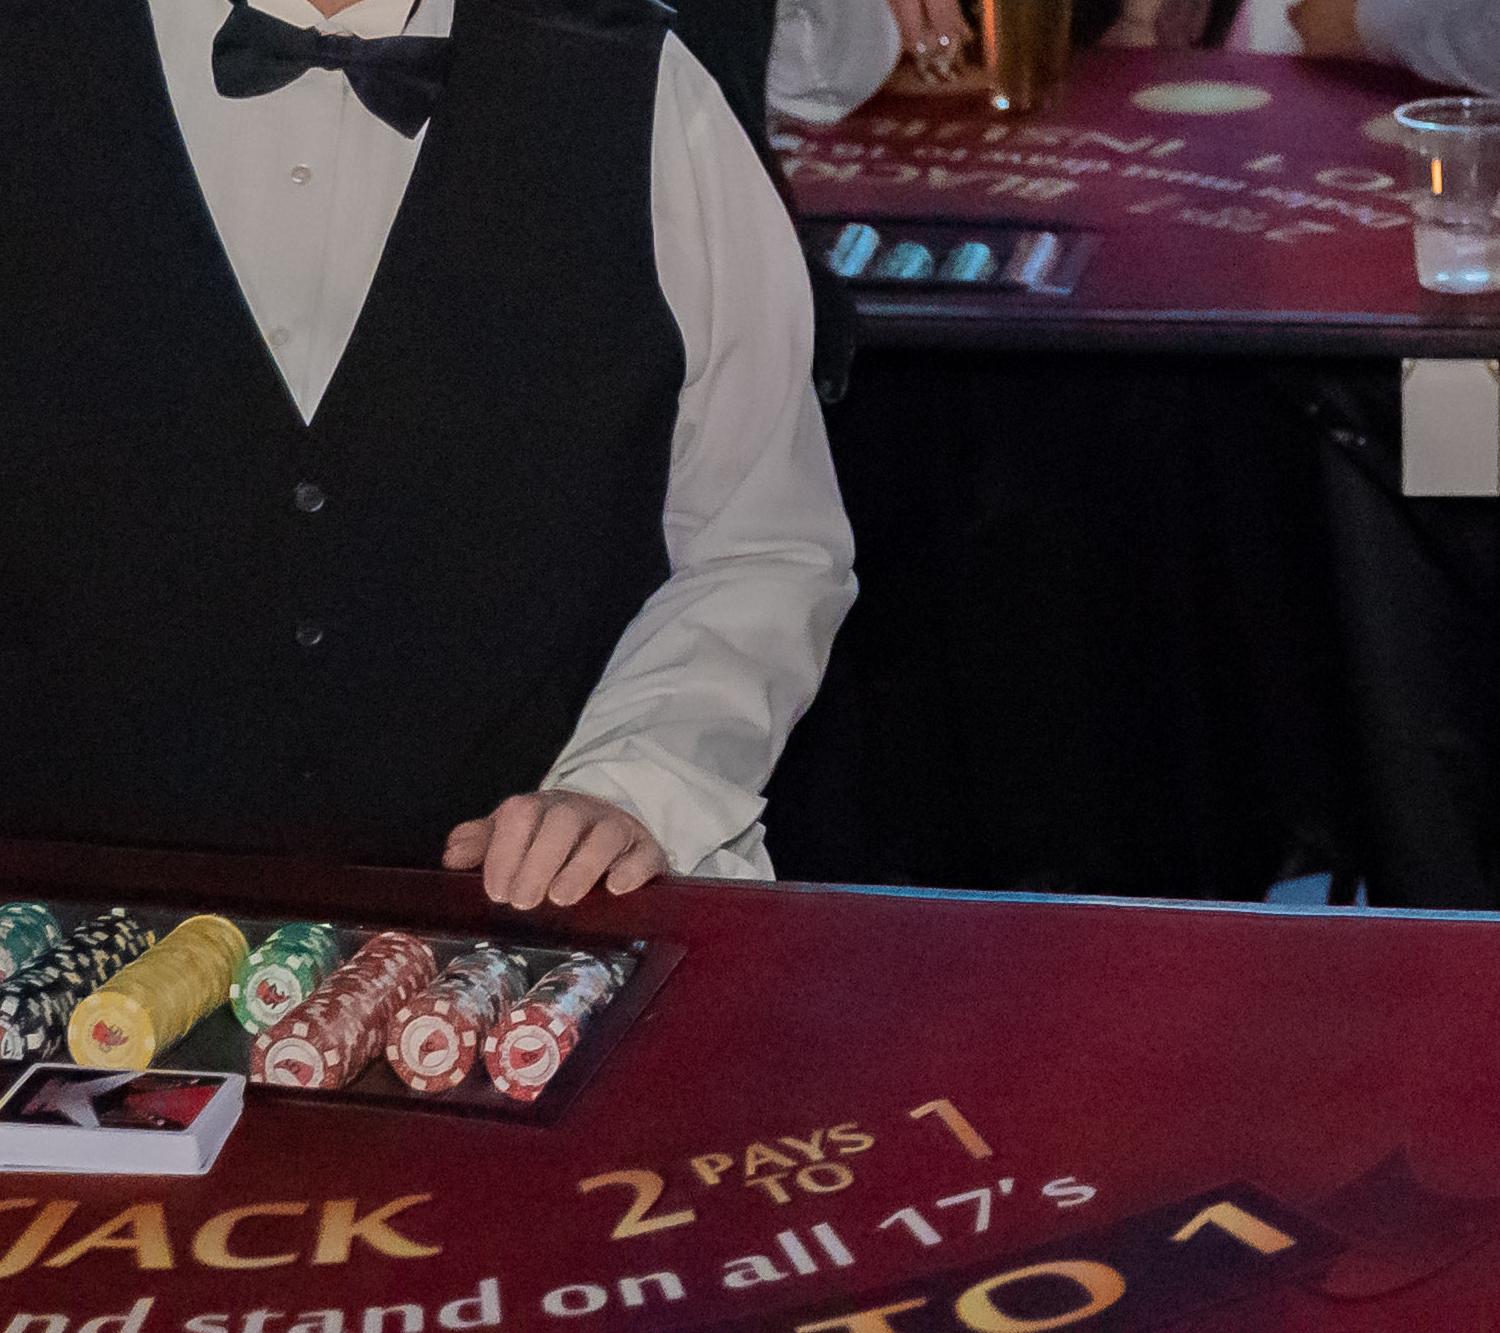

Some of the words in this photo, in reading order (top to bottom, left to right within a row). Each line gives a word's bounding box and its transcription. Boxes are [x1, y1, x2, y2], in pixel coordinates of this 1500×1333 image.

[689, 1121, 875, 1185] PAYS
[909, 1098, 992, 1159] 1
[578, 1169, 695, 1239] 2
[746, 1162, 854, 1203] TO
[183, 1278, 500, 1333] stand
[541, 1271, 686, 1319] on
[723, 1222, 855, 1289] all
[878, 1175, 1097, 1246] 17's
[1171, 1201, 1297, 1255] 1
